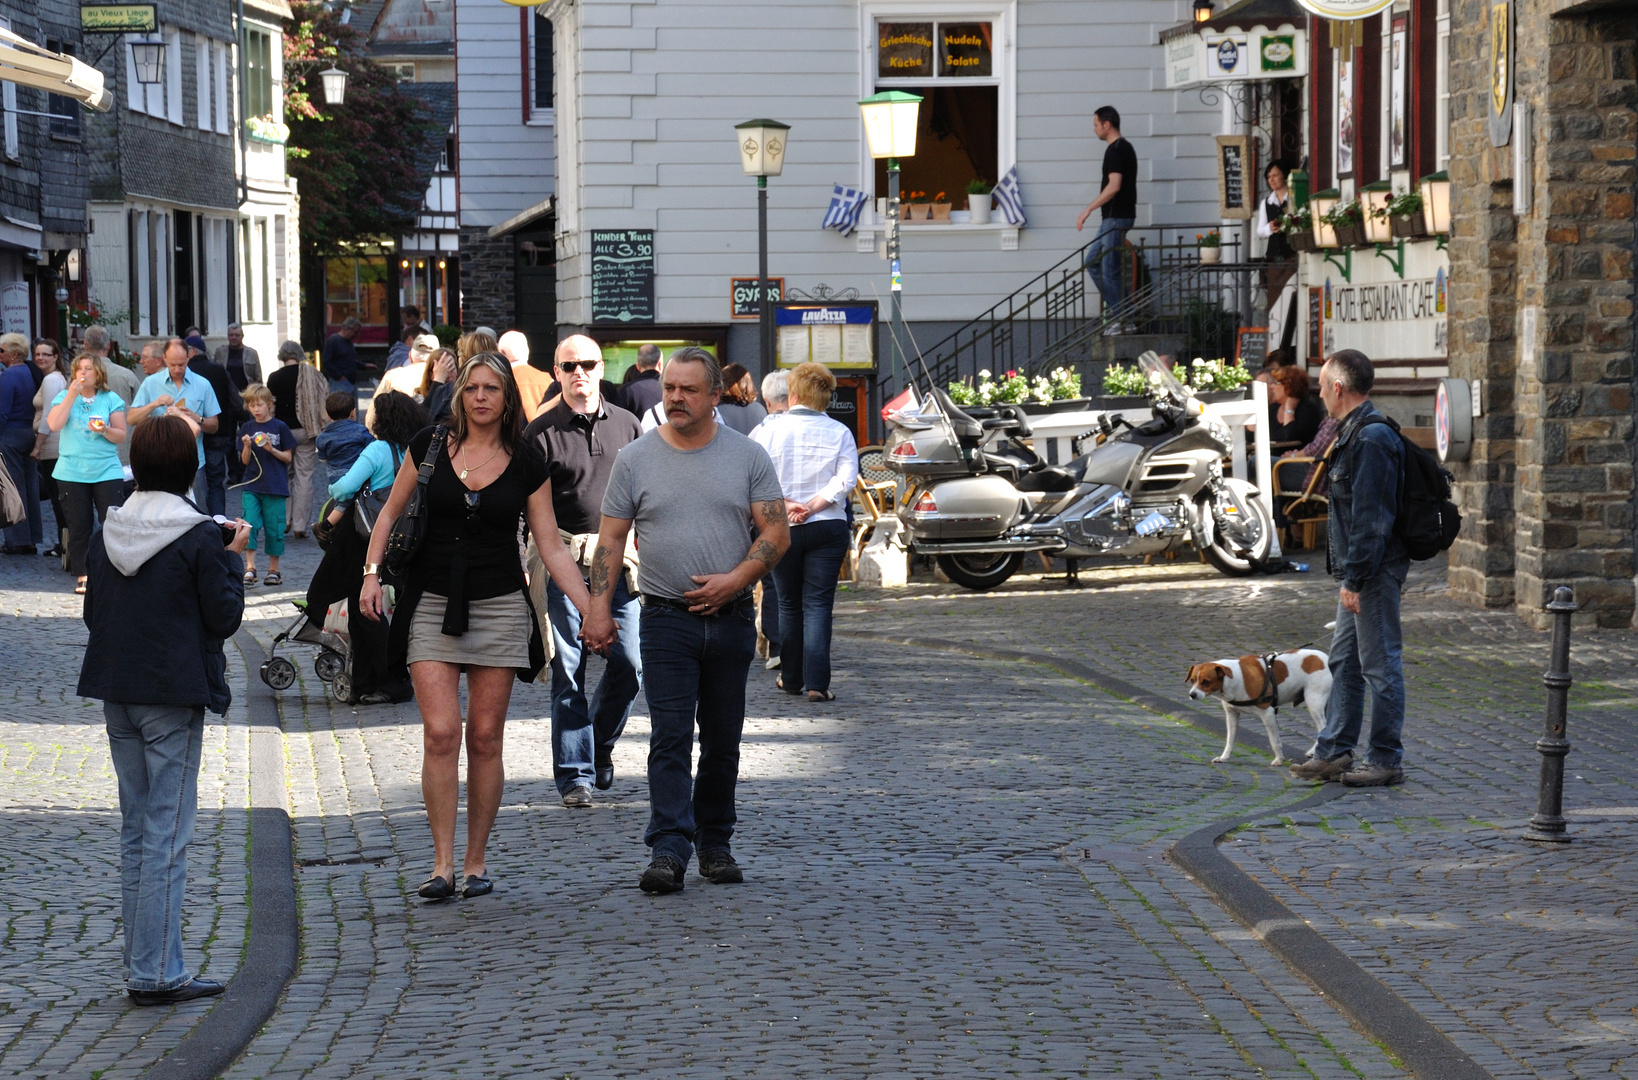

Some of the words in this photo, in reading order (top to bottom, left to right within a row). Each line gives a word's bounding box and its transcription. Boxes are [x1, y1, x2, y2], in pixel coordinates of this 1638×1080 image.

[126, 9, 148, 17] Liège
[880, 33, 932, 48] Griechische
[944, 35, 982, 46] Nudeln
[889, 56, 922, 68] Küche
[946, 55, 980, 66] Salate
[594, 232, 626, 242] KINDER
[595, 244, 615, 253] ALLE
[617, 243, 652, 256] 3,90
[1336, 288, 1357, 322] HOTEL
[1360, 284, 1408, 320] RESTAURANT
[802, 308, 847, 321] LAVAZZA
